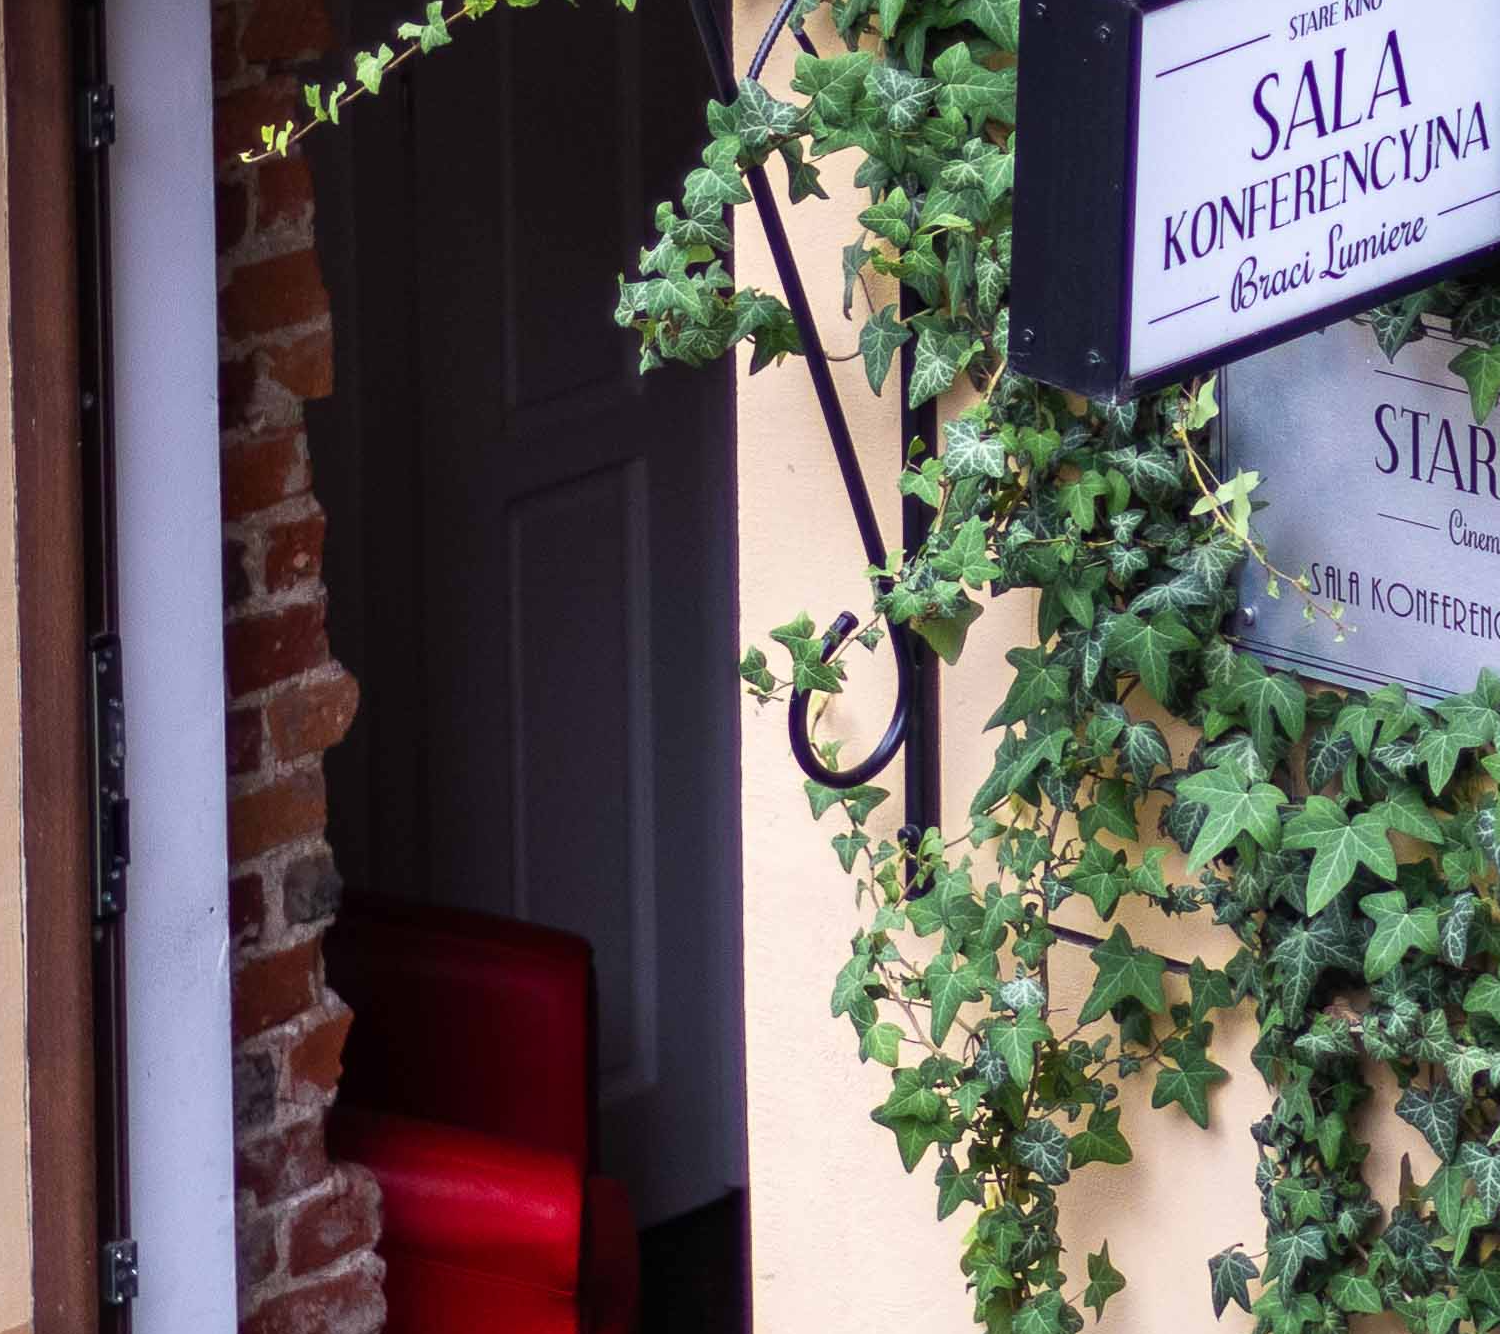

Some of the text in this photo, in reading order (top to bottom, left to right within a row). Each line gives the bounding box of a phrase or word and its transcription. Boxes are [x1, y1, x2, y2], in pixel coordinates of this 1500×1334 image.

[1288, 0, 1340, 41] STARE
[1251, 28, 1412, 162] SALA
[1162, 101, 1491, 271] KONFERENCYJNA
[1230, 216, 1428, 313] Braci Lumiere
[1310, 562, 1360, 606] SALA
